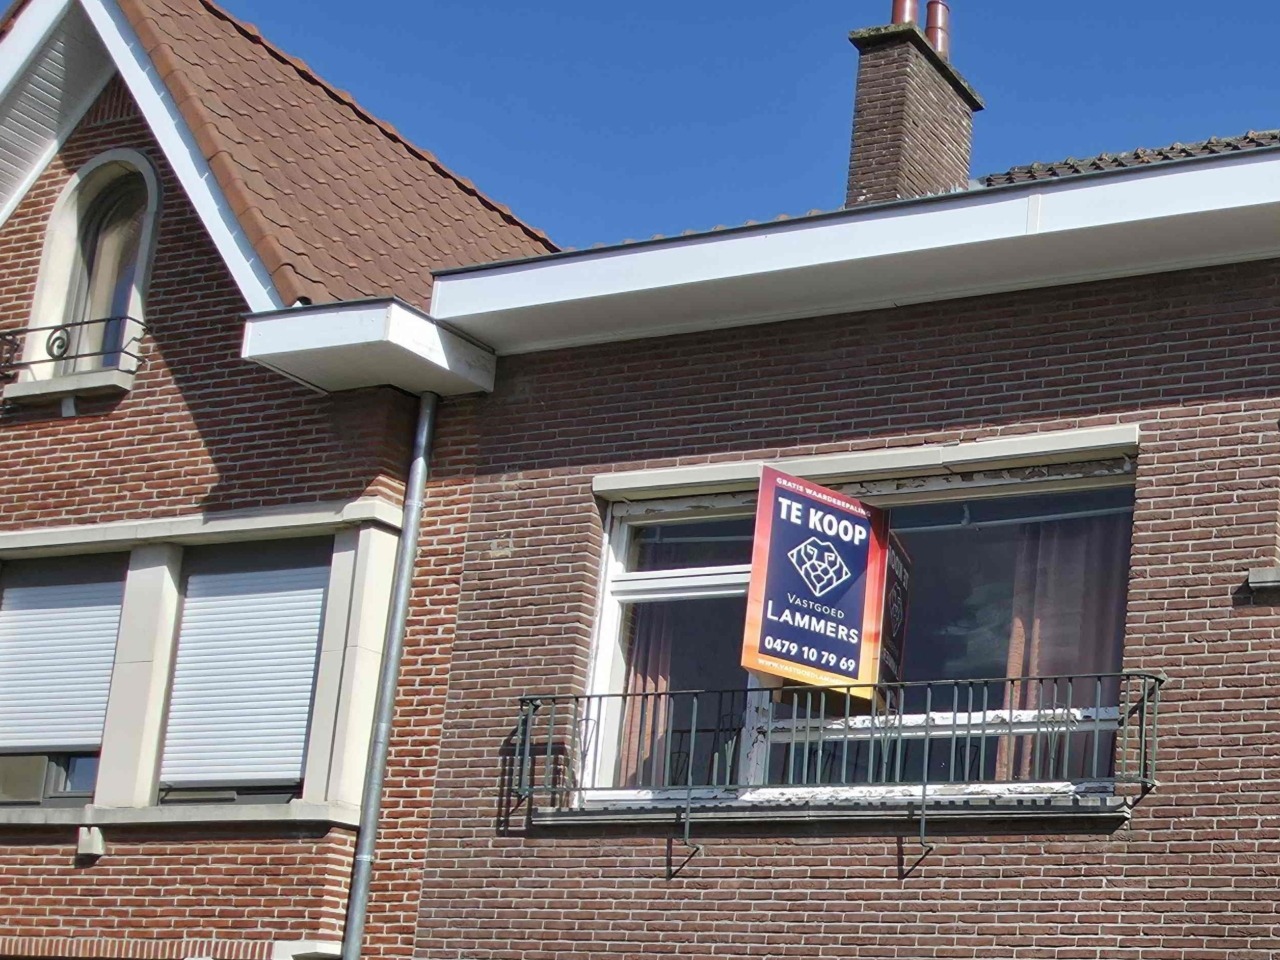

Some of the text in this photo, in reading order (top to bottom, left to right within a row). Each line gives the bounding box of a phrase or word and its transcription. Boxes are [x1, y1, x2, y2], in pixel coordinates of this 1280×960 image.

[776, 477, 871, 517] GRATIS WAARDEBEPALING
[778, 497, 867, 545] TE KOOP
[766, 600, 859, 644] LAMMERS
[787, 593, 845, 619] VASTGOED
[764, 636, 856, 671] 0479 10 79 69
